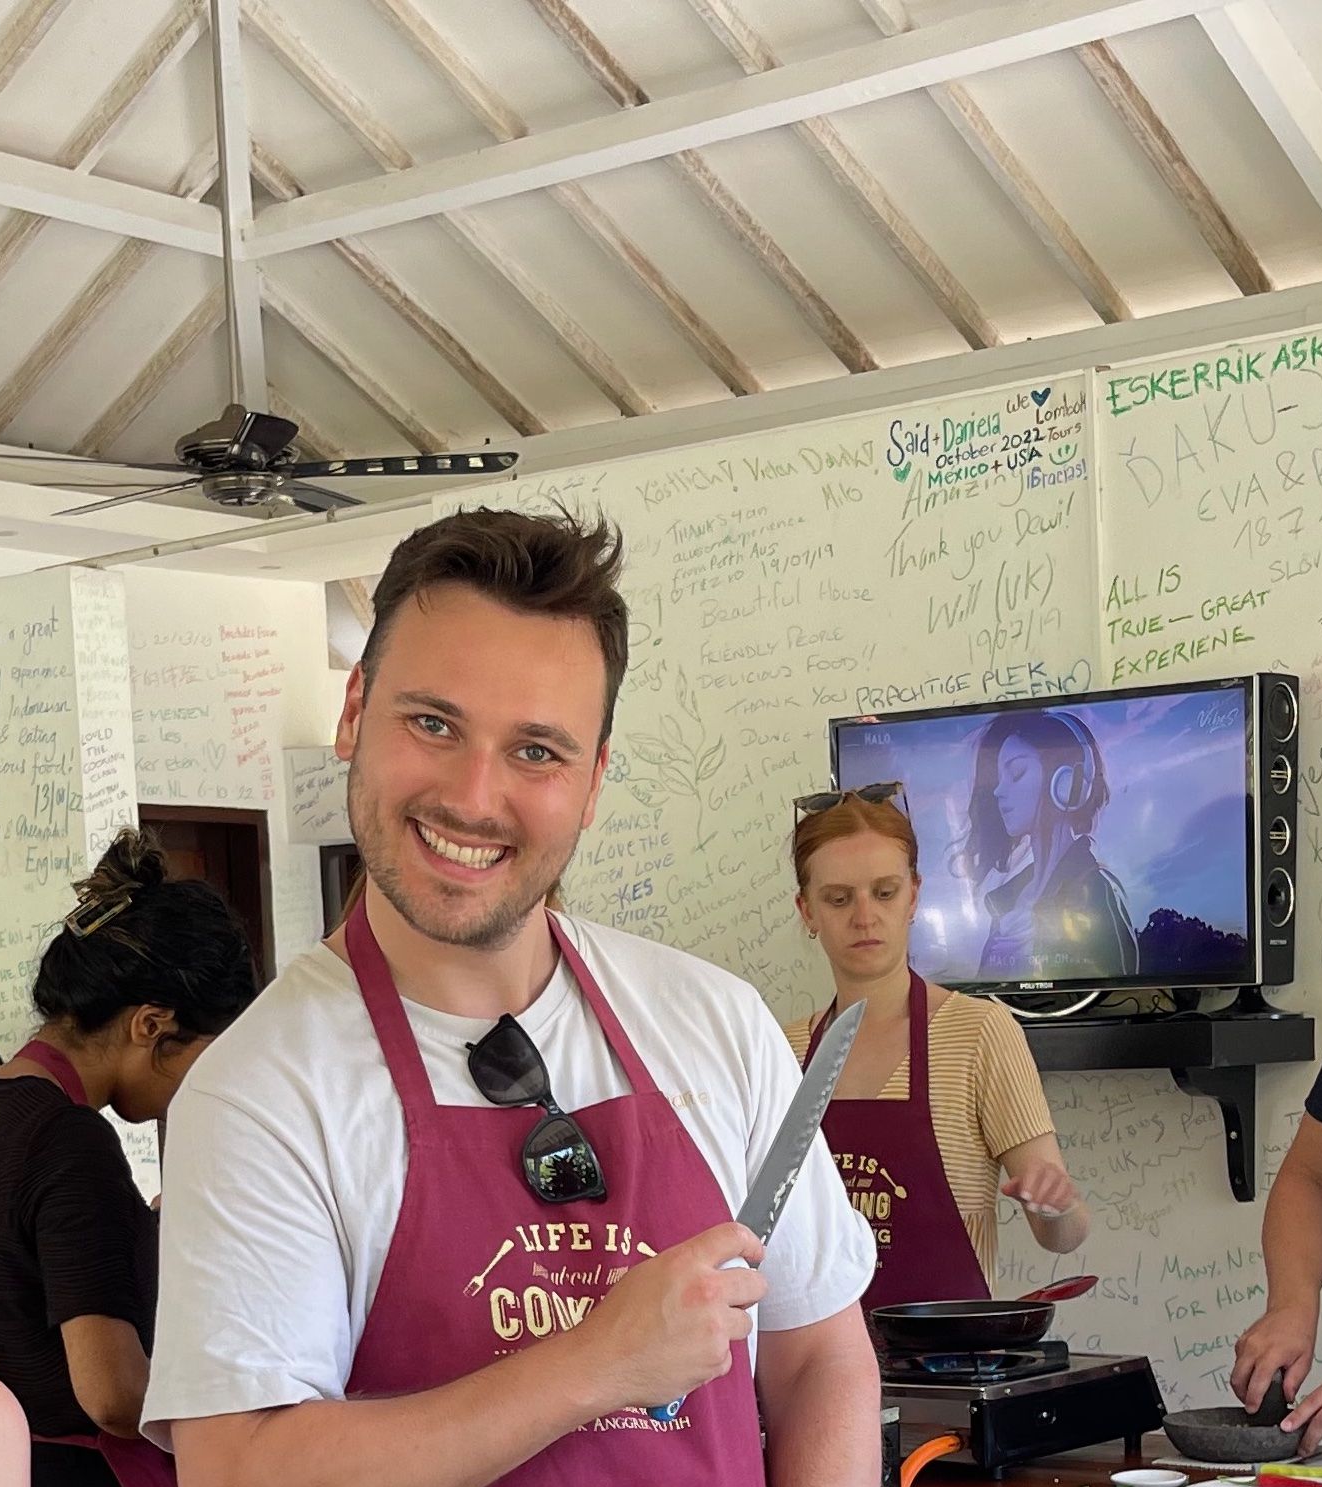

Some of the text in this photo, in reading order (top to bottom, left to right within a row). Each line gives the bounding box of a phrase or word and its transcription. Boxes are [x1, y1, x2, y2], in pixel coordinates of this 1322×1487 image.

[887, 412, 1001, 466] Said Daniela
[1001, 428, 1045, 452] 2022
[1047, 423, 1081, 442] Tours
[1007, 447, 1042, 469] USA
[885, 520, 949, 577] Thank
[952, 523, 1002, 580] you
[1106, 564, 1181, 612] ALL IS
[1107, 590, 1271, 644] TRUE GREAT
[982, 662, 1048, 693] PLEK
[832, 1153, 878, 1174] FE IS
[516, 1223, 632, 1256] LIFE IS
[650, 1416, 690, 1432] PUTIH
